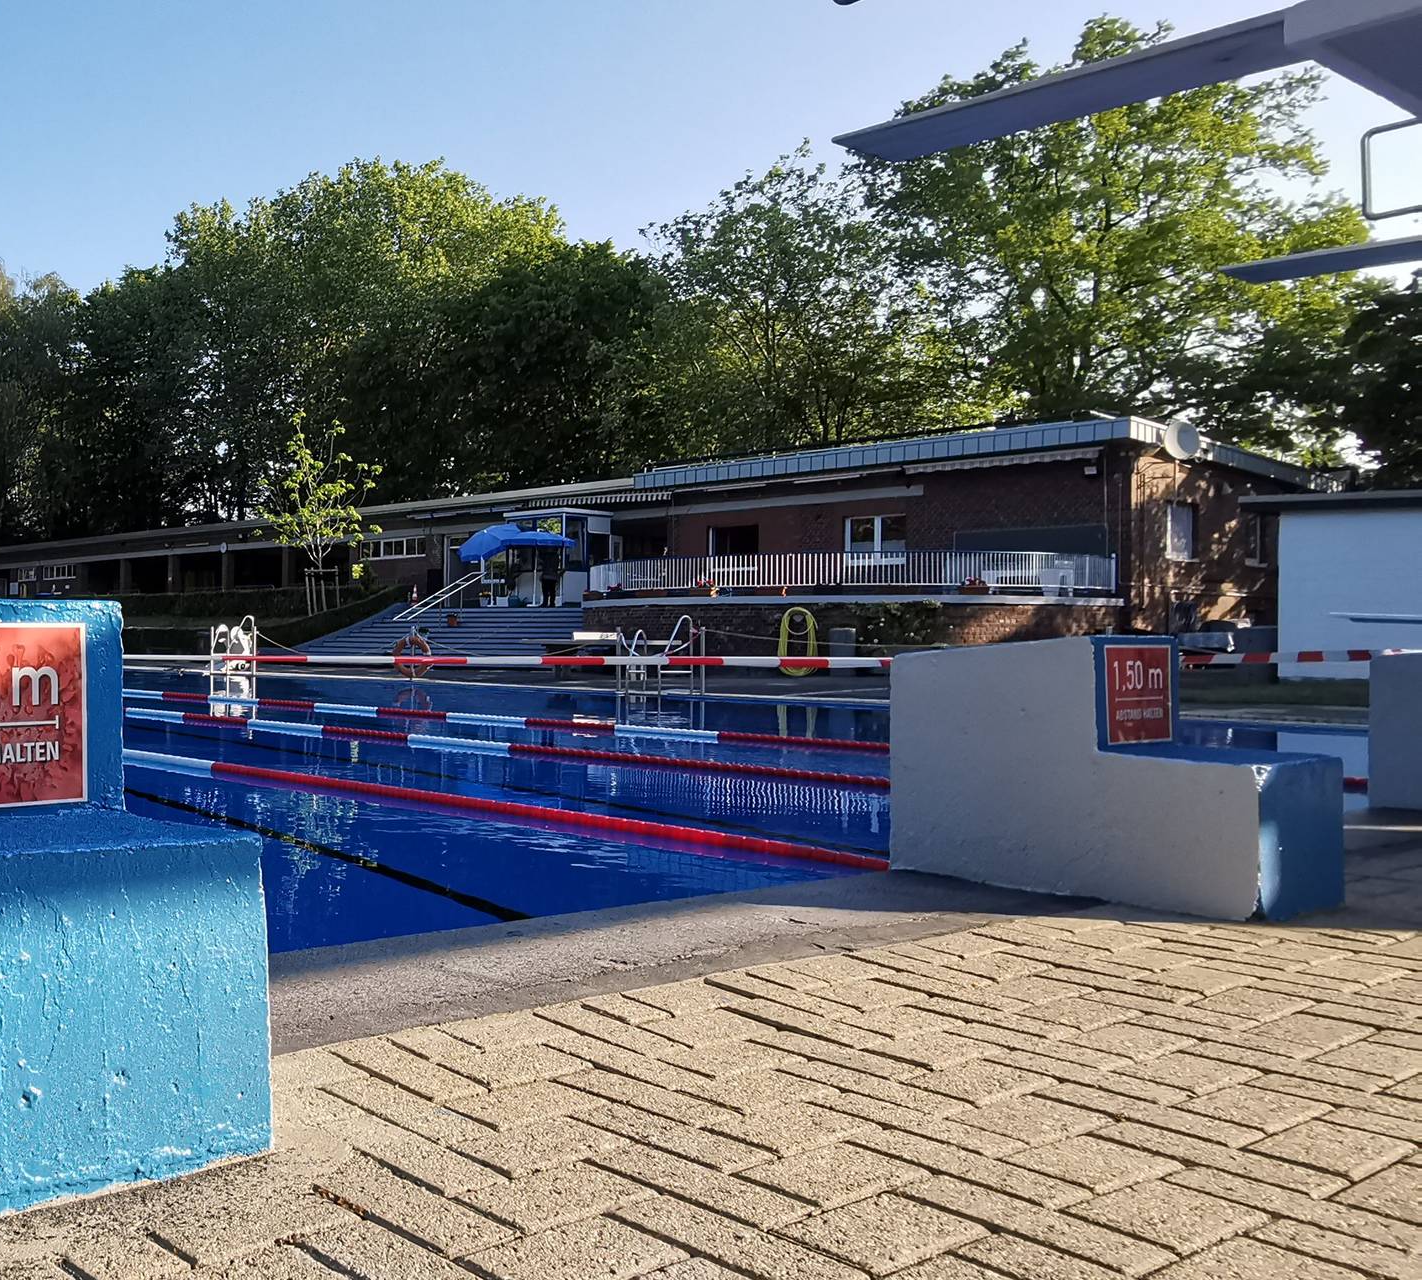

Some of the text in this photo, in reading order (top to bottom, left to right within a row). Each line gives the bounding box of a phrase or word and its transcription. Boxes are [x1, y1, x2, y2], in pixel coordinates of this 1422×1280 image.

[11, 665, 60, 707] m
[1113, 660, 1163, 691] 1,50 m
